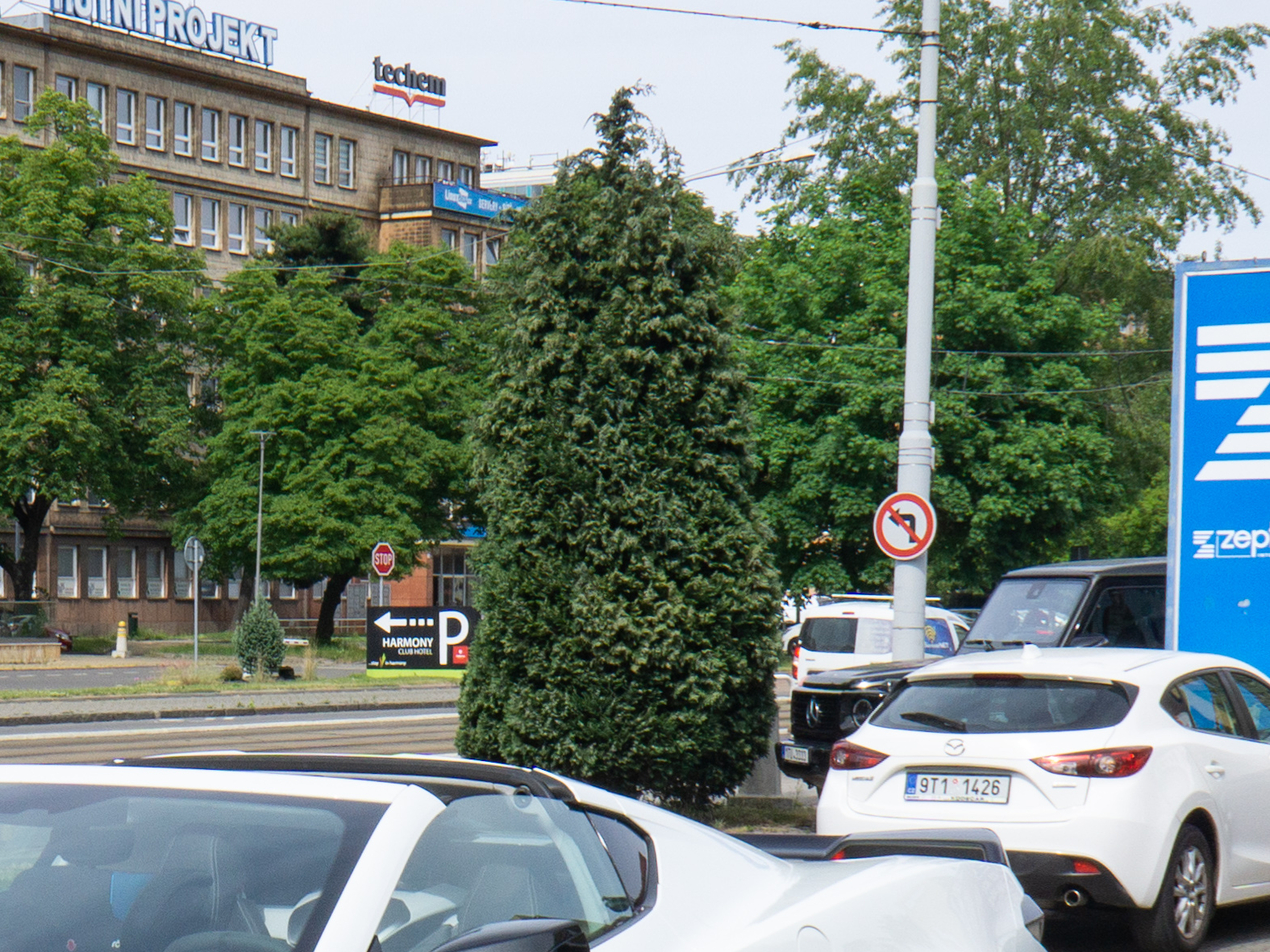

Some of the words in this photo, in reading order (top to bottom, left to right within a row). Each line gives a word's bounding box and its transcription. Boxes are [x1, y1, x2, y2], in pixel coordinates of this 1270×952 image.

[146, 0, 278, 65] PROJEKT
[373, 55, 446, 96] techem
[1216, 529, 1270, 558] zep
[375, 553, 392, 565] STOP
[382, 637, 433, 648] HARMONY
[439, 610, 469, 665] P
[919, 777, 948, 794] 9T1
[963, 778, 1001, 795] 1426
